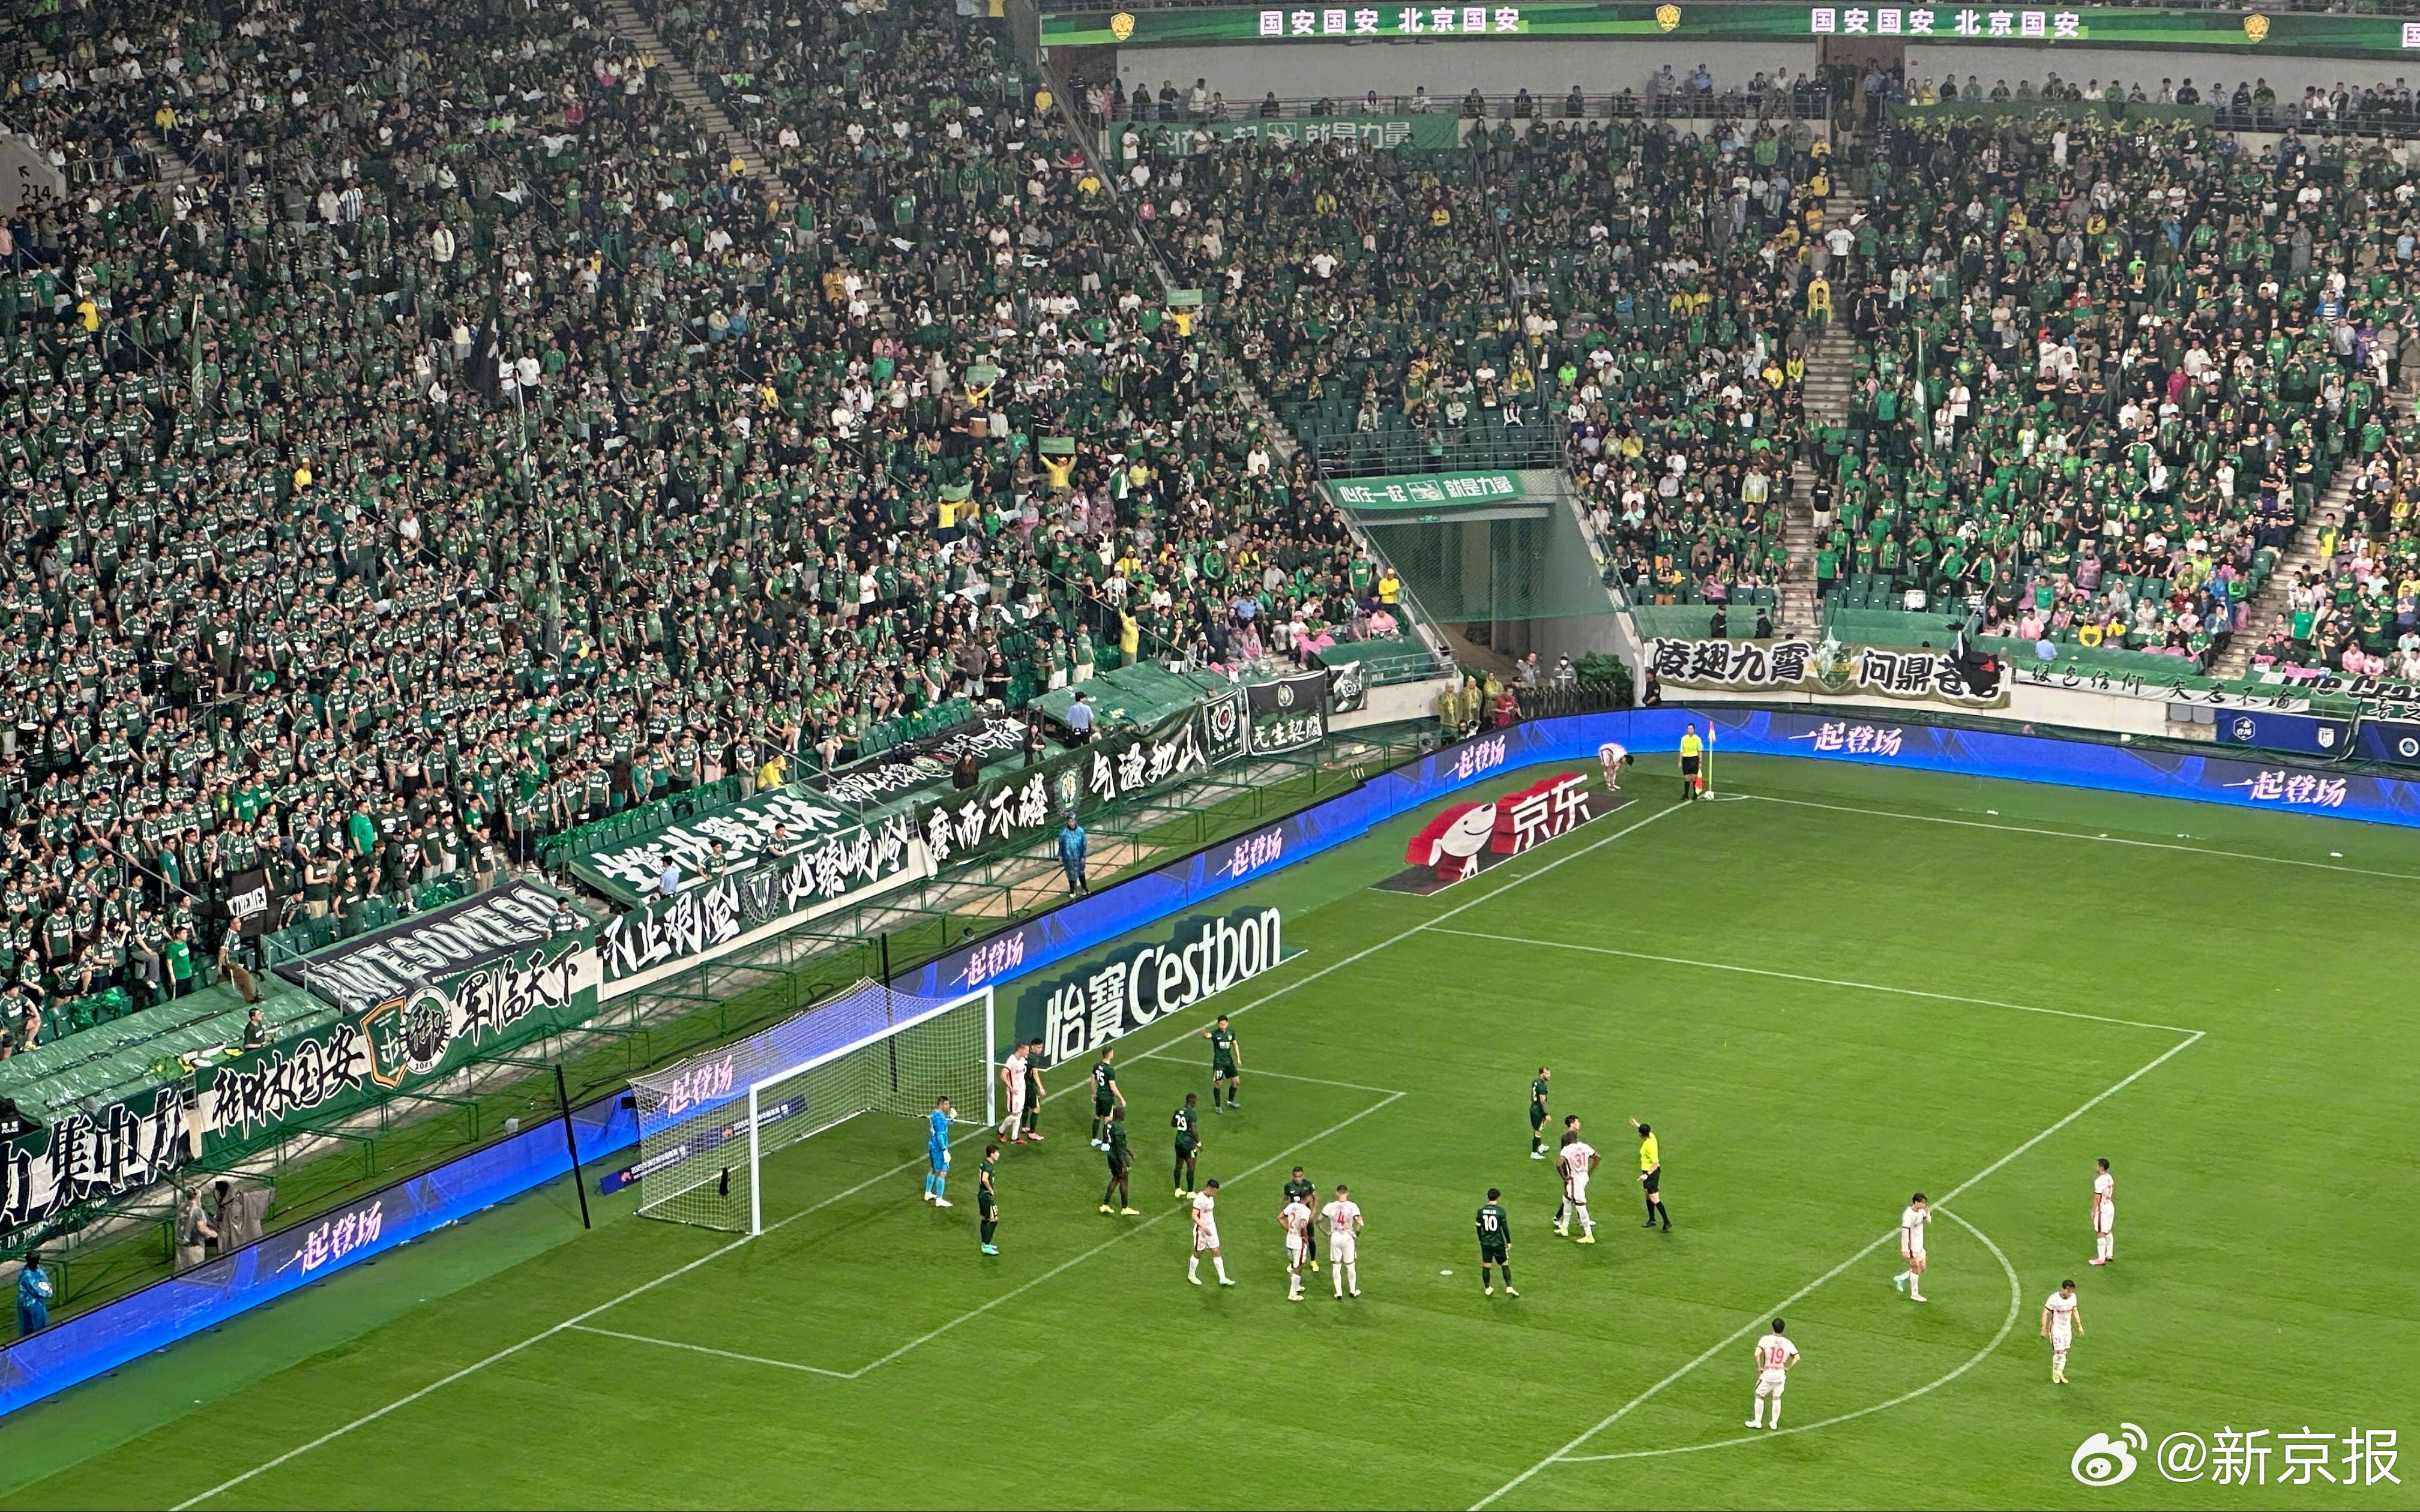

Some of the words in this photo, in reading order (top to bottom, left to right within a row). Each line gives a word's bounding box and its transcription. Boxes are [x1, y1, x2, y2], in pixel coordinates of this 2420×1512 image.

[1260, 8, 1379, 35] 国安国安
[1398, 7, 1520, 34] 北京国安
[1811, 8, 1934, 34] 国安国安
[1955, 9, 2080, 37] 北京国安
[1305, 122, 1412, 149] 就是力量
[21, 183, 51, 201] 214
[1338, 484, 1408, 503] 心在一起
[1443, 475, 1514, 498] 就是力量
[1788, 722, 1903, 757] 一起登场
[1444, 734, 1506, 781] 一起登场
[2222, 770, 2347, 808] 一起登场
[1510, 773, 1591, 854] 京东
[1215, 827, 1282, 880] 一起登场
[950, 931, 1024, 989] 一起登场
[656, 1054, 733, 1119] 一起登场
[1096, 1069, 1105, 1087] 15
[1175, 1114, 1188, 1132] 29
[1574, 1151, 1586, 1168] 31
[1337, 1211, 1345, 1226] 4
[1482, 1214, 1498, 1232] 10
[275, 1201, 382, 1277] 一起登场
[1770, 1346, 1784, 1364] 19
